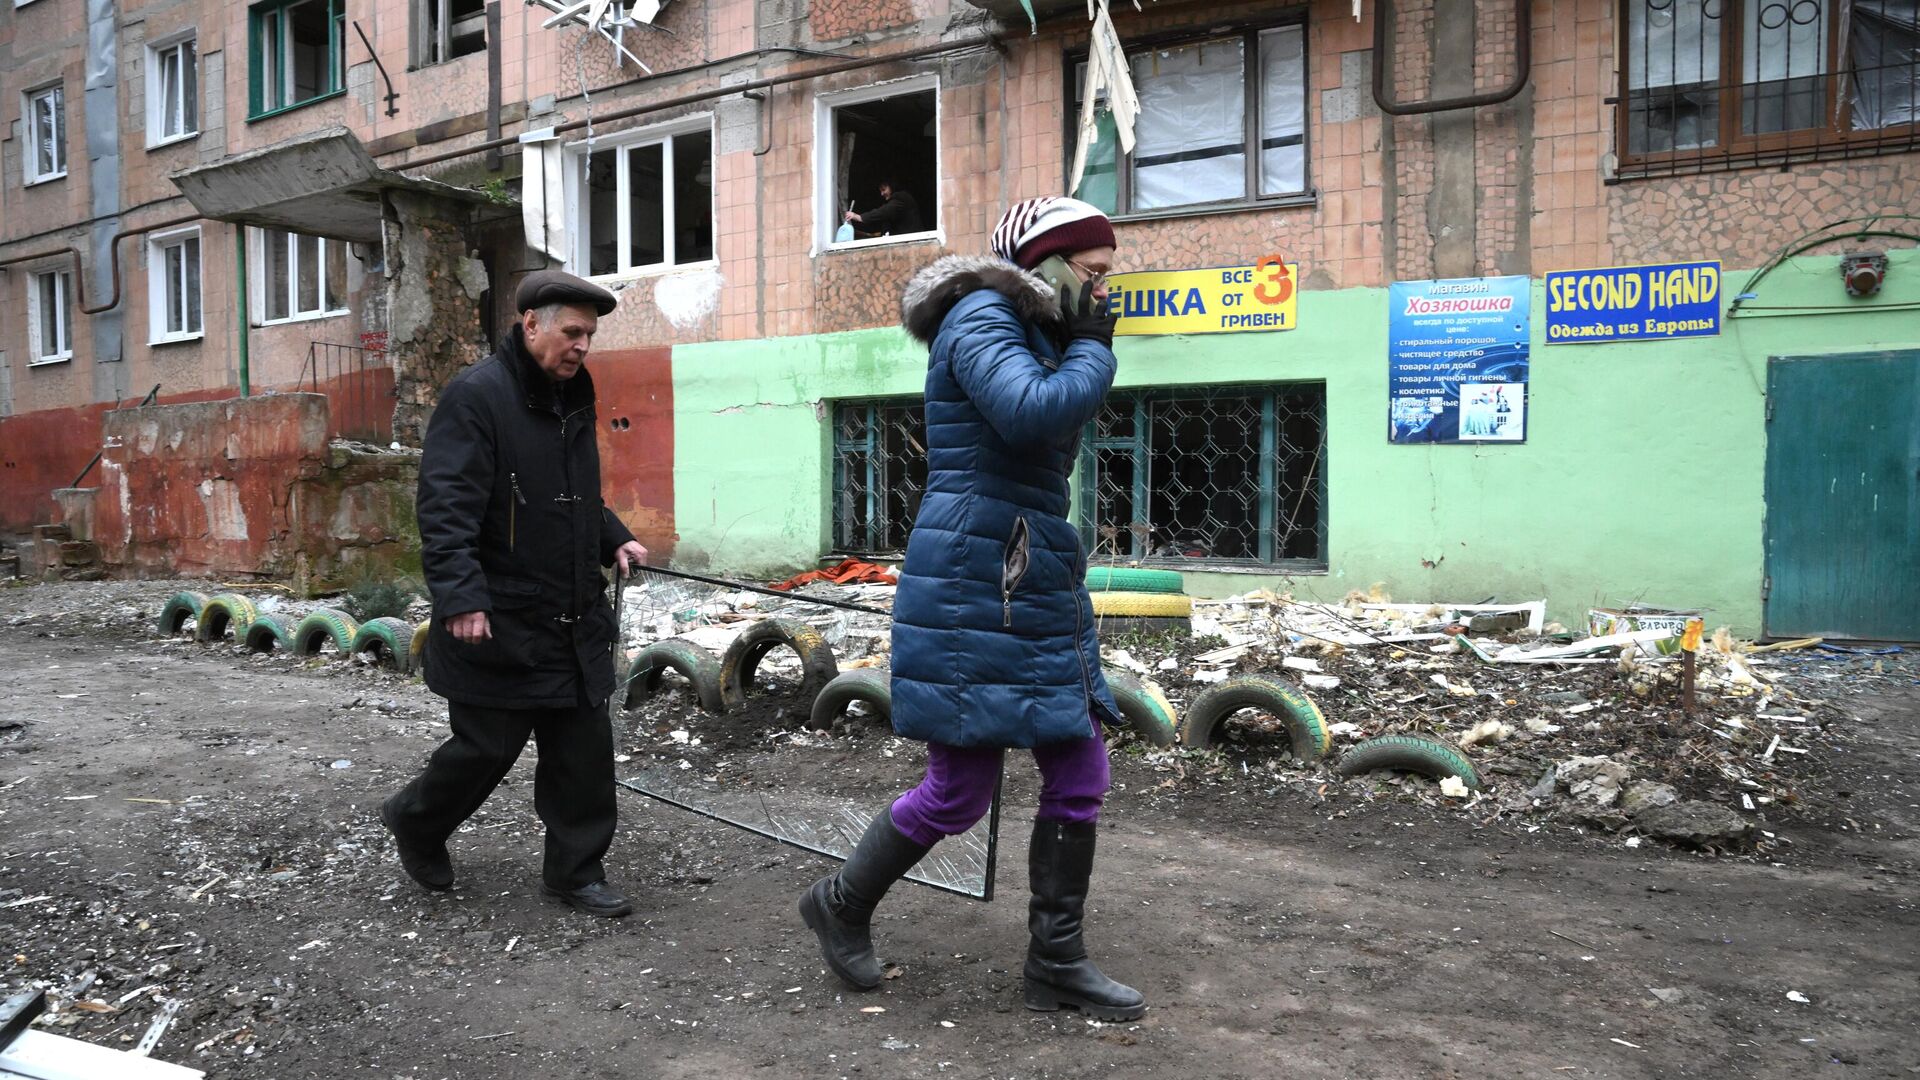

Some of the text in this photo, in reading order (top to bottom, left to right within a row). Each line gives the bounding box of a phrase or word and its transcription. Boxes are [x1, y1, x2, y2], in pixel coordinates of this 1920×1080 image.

[1221, 270, 1253, 284] ВСЕ
[1221, 254, 1293, 306] ОТ 3
[1428, 282, 1489, 295] магазин
[1549, 267, 1718, 312] SECOND HAND
[1106, 285, 1206, 319] ЁШКА
[1406, 297, 1512, 314] Хозяюшка
[1221, 312, 1285, 328] ГРИВЕН
[1413, 319, 1442, 327] всегда
[1456, 316, 1504, 326] доступной
[1445, 326, 1470, 334] цене:
[1550, 317, 1714, 339] Одежда из Европы
[1399, 337, 1453, 347] стиральный
[1455, 336, 1497, 347] порошок
[1399, 350, 1442, 359] чистящее
[1443, 349, 1484, 359] средство
[1399, 363, 1431, 372] товары
[1433, 363, 1450, 371] для
[1452, 362, 1477, 371] дома
[1399, 375, 1431, 384] товары
[1433, 373, 1467, 382] личной
[1468, 373, 1507, 382] гигиены
[1399, 387, 1446, 395] косметика
[1398, 399, 1459, 409] рикотаные
